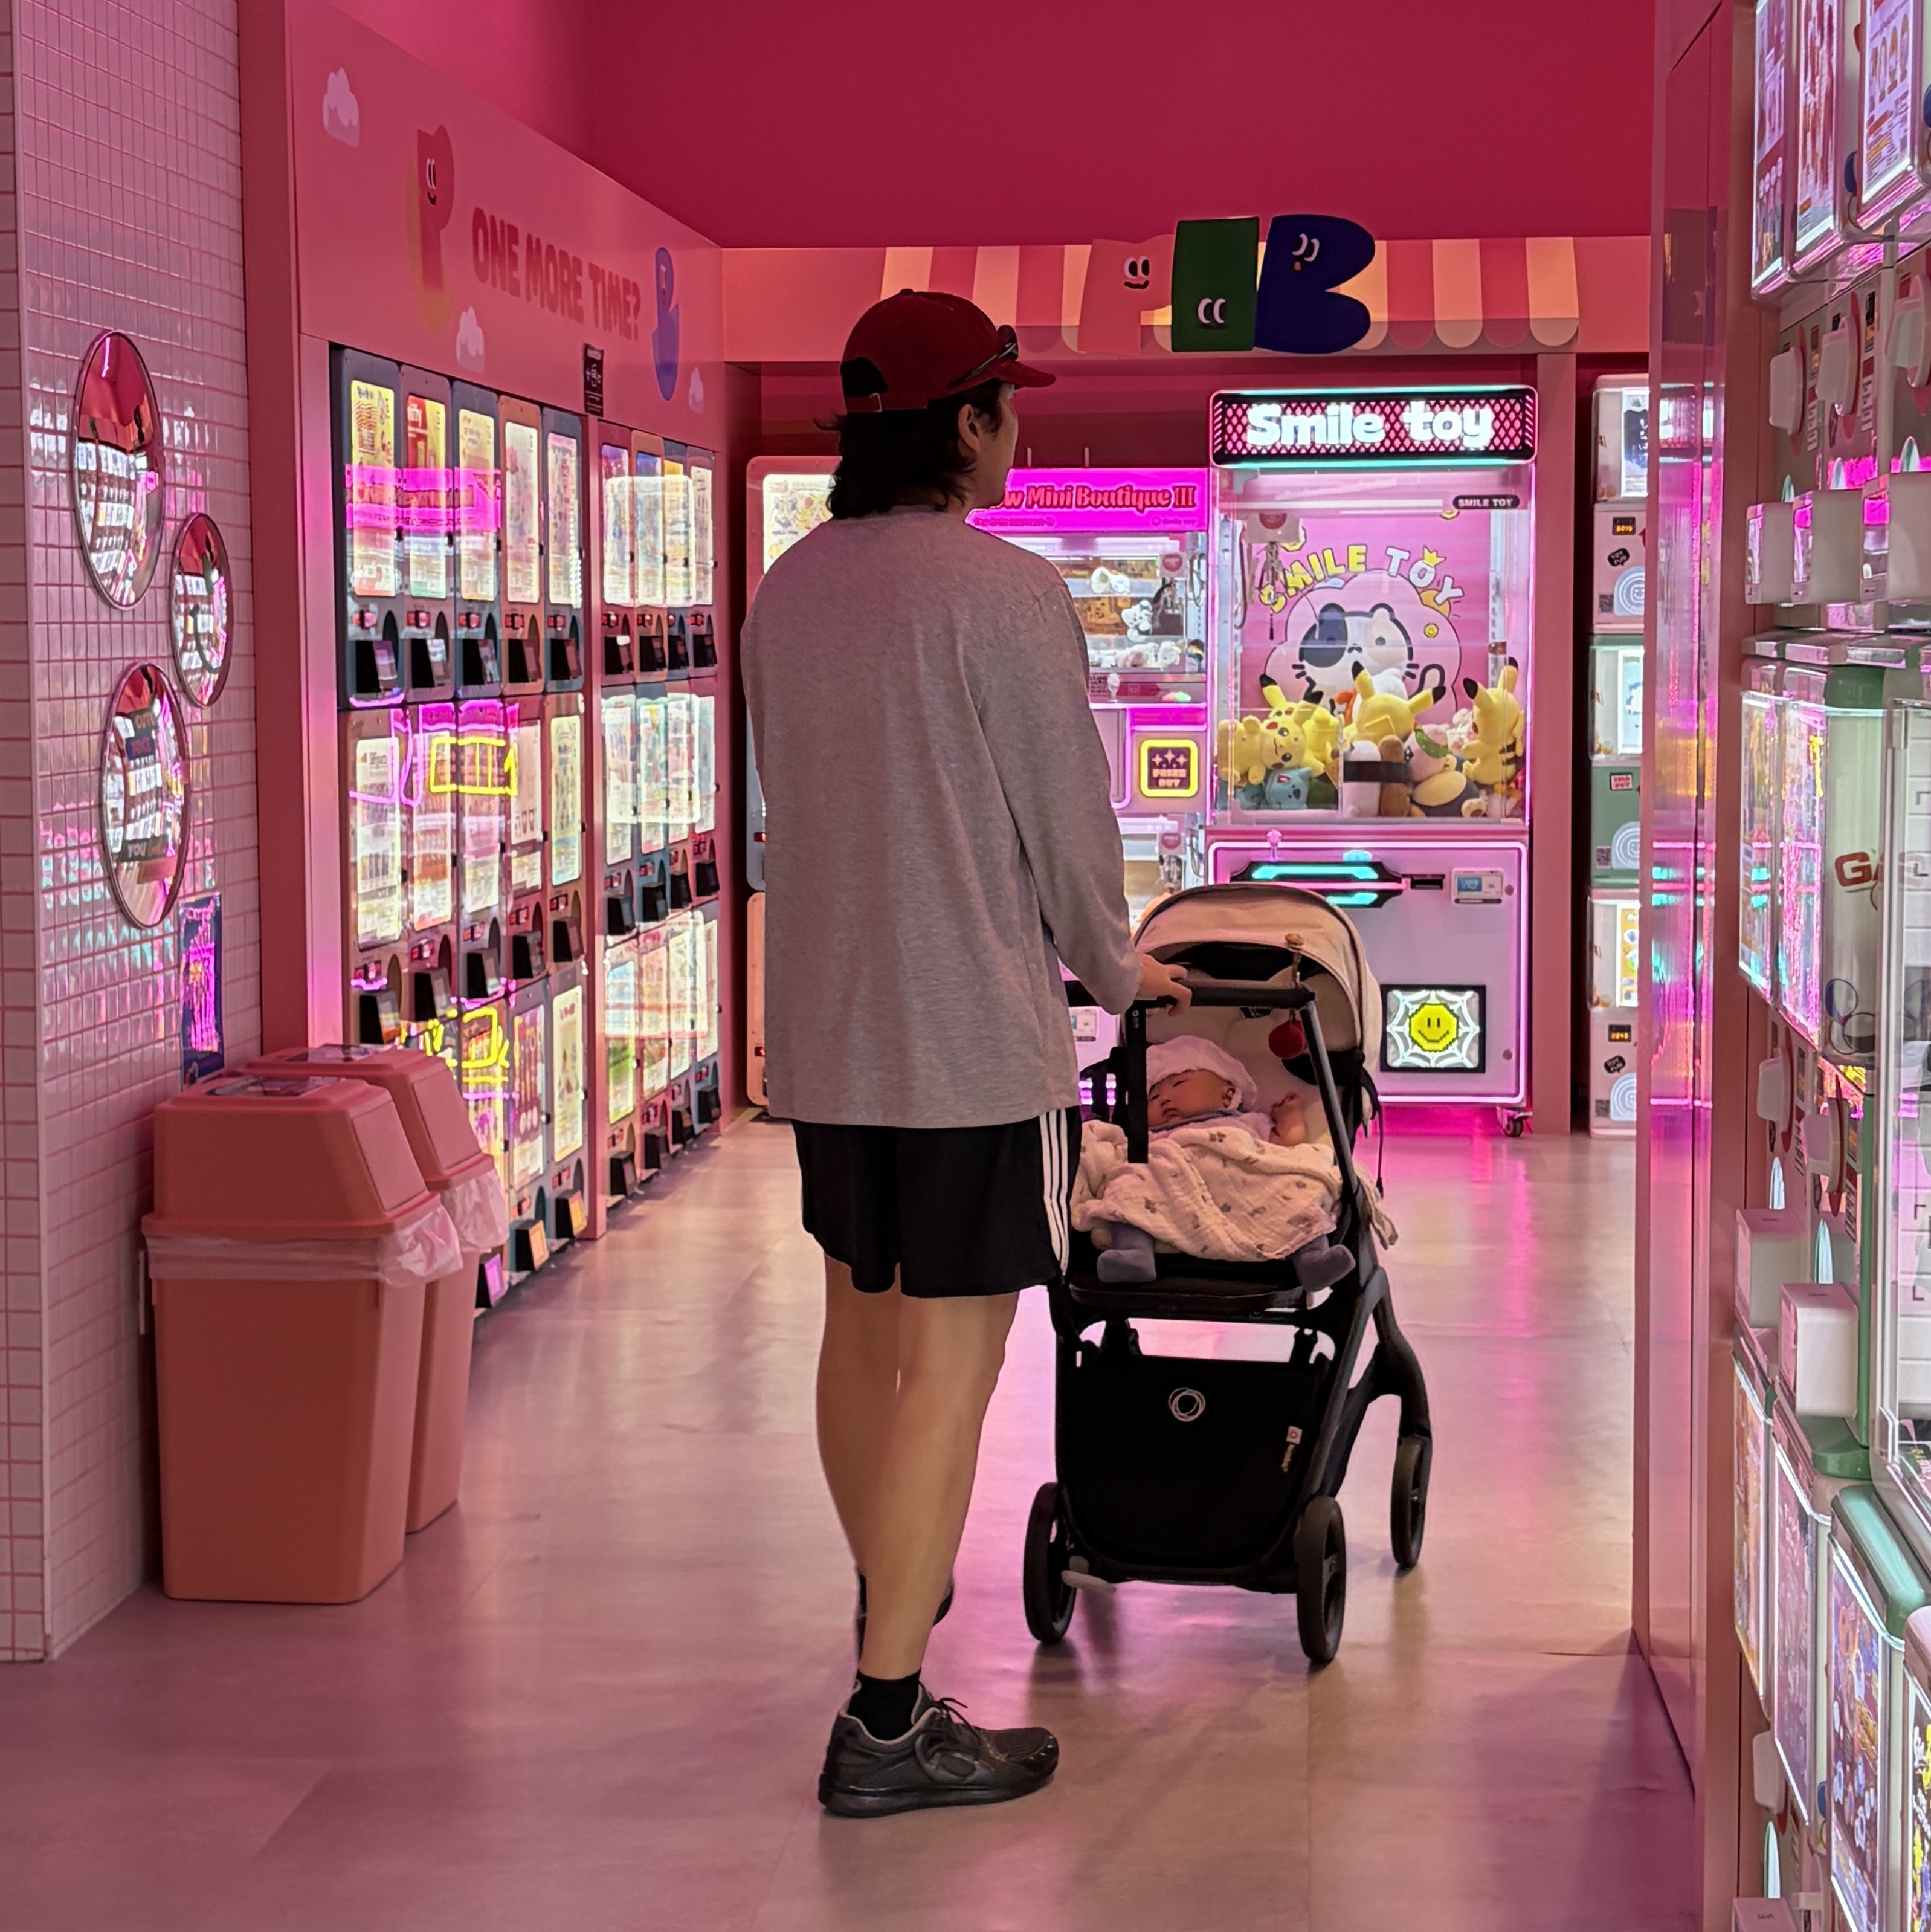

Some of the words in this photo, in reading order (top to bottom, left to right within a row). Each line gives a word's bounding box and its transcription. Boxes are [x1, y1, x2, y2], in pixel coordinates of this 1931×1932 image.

[472, 207, 520, 298] ONE
[525, 233, 584, 325] MORE
[588, 262, 641, 341] TIME?
[1246, 403, 1385, 446] Smile
[1402, 401, 1492, 448] toy
[1026, 485, 1074, 509] Mini
[1075, 484, 1172, 513] Boutique
[1173, 485, 1196, 508] III
[1458, 498, 1489, 507] SMILE
[1492, 498, 1513, 507] TOY
[1386, 546, 1465, 605] TOY
